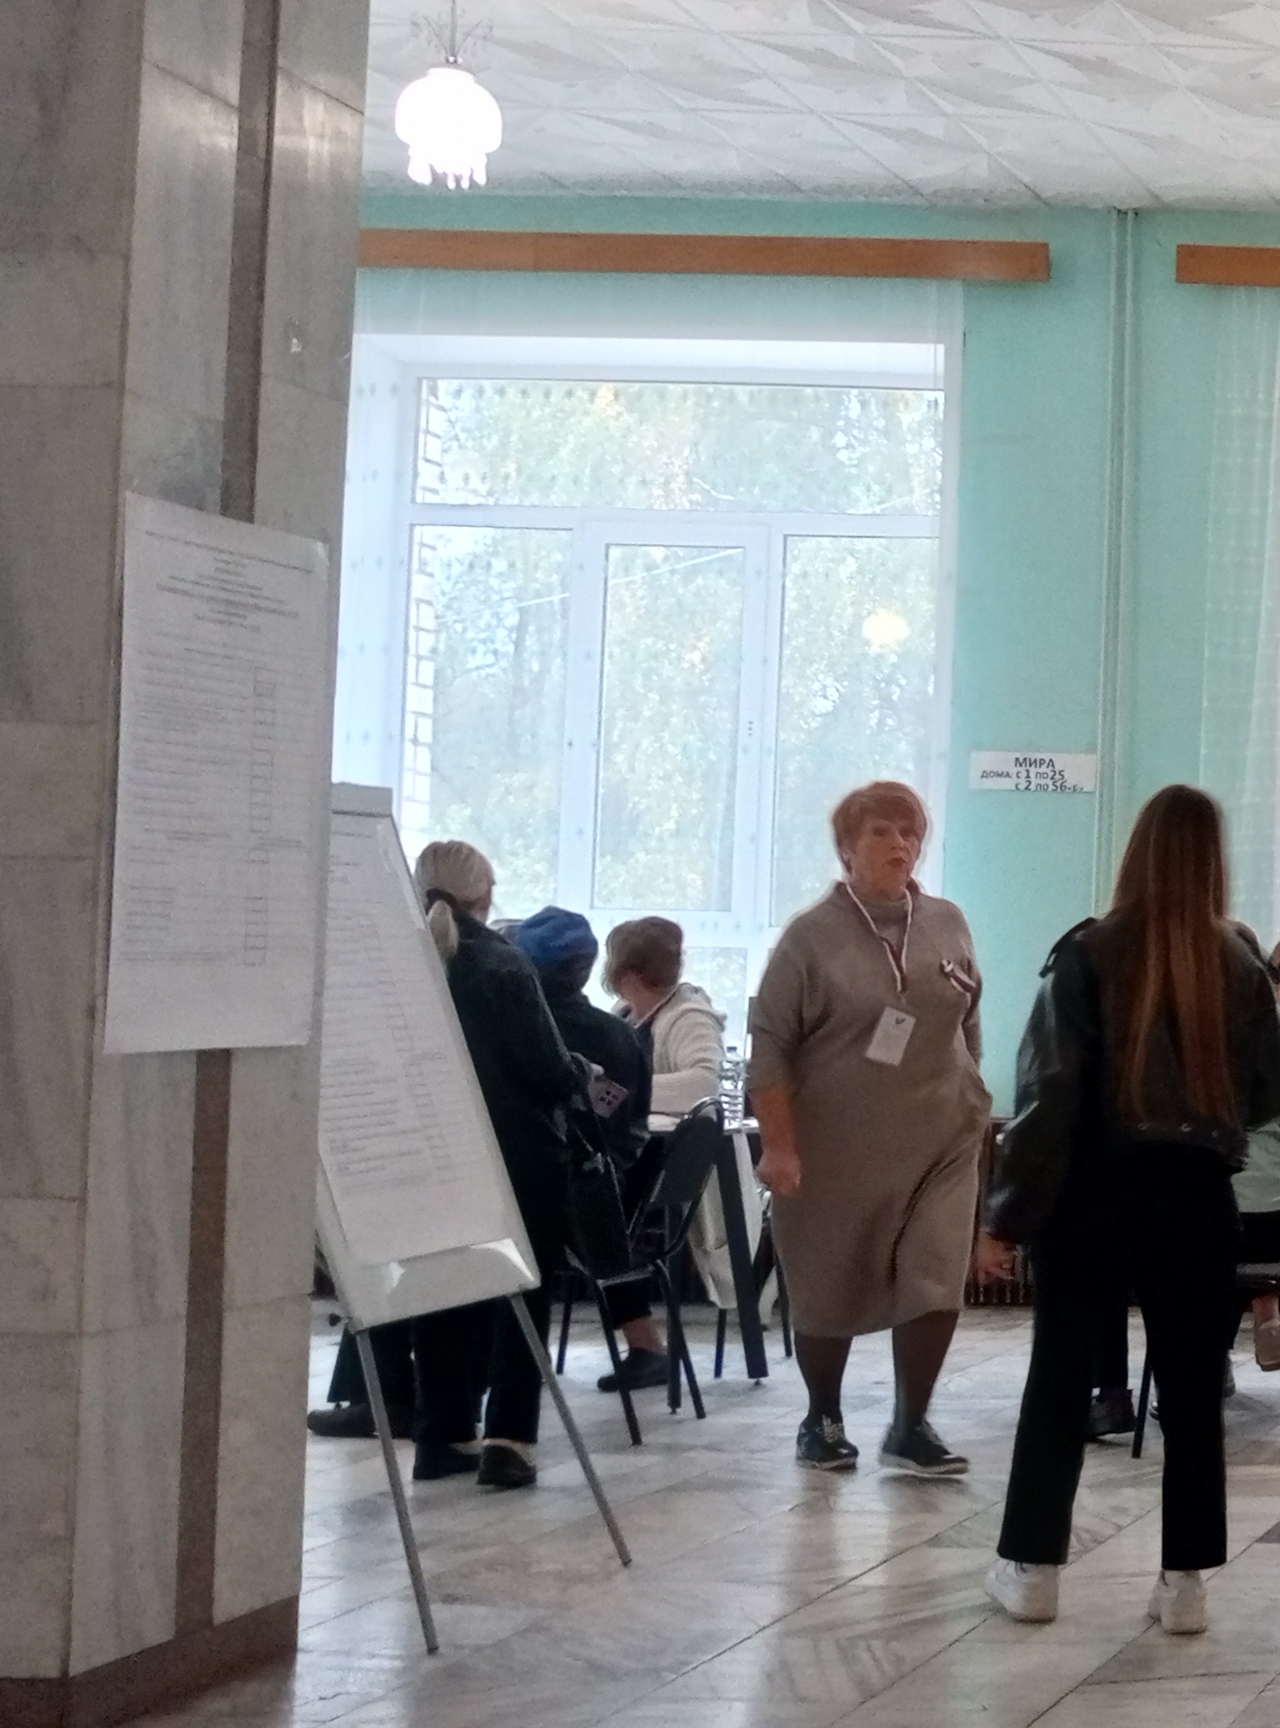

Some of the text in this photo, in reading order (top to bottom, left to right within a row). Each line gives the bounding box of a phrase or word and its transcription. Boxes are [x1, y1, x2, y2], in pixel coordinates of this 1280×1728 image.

[1014, 757, 1056, 769] МИРА
[1024, 769, 1031, 779] 1
[1035, 771, 1049, 780] по
[1050, 769, 1065, 781] 25
[1024, 780, 1032, 791] 2
[1035, 783, 1049, 792] по
